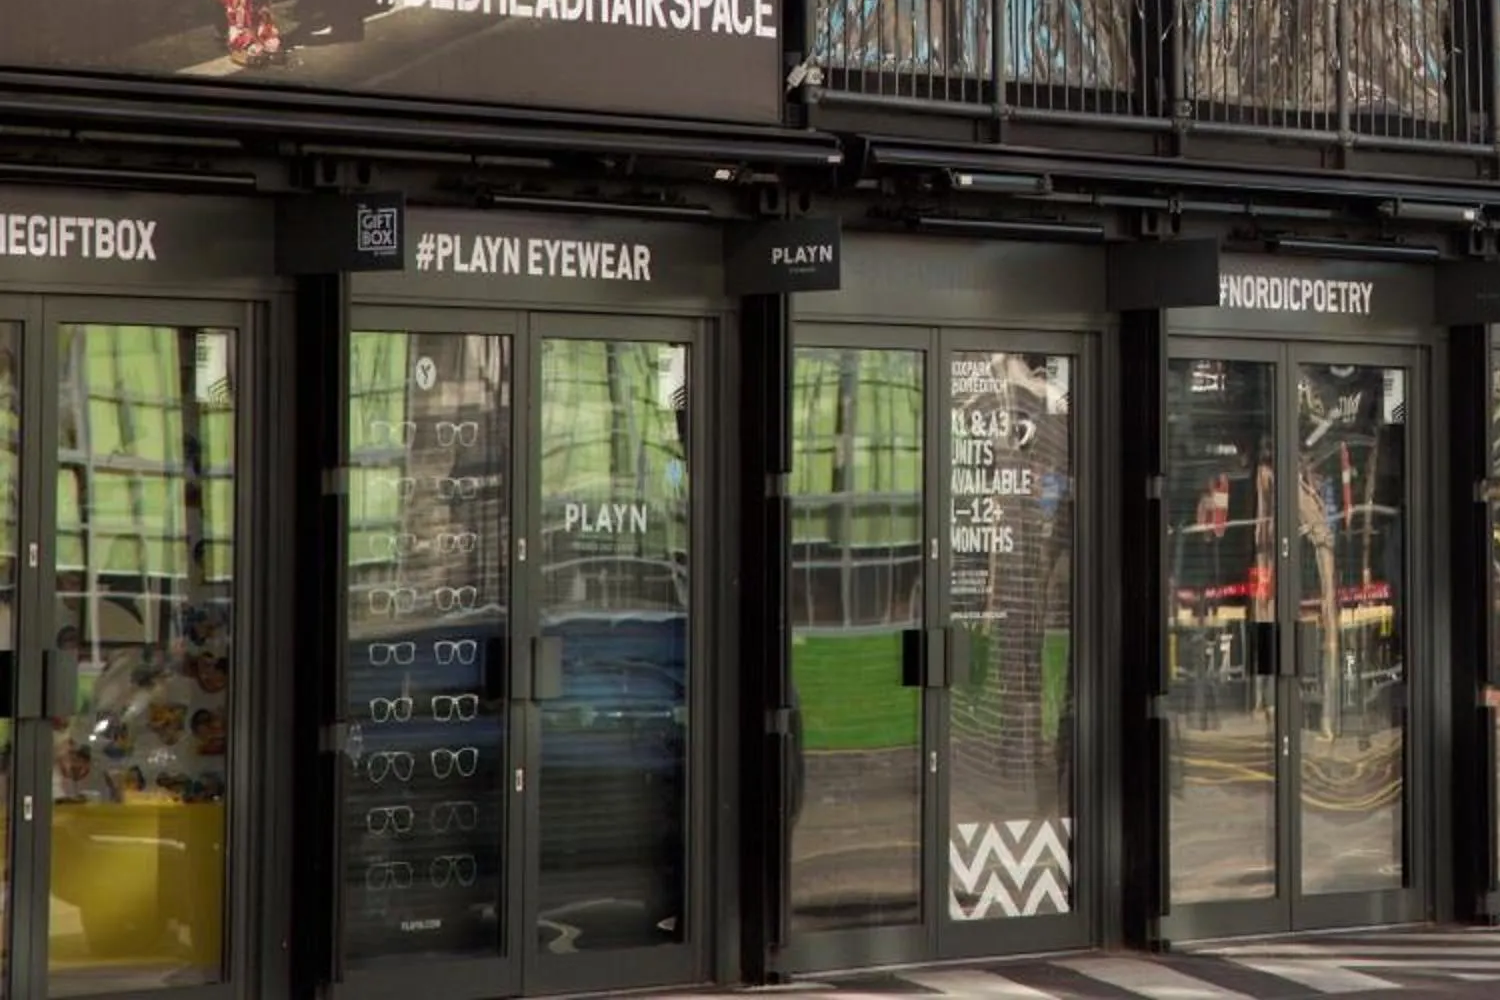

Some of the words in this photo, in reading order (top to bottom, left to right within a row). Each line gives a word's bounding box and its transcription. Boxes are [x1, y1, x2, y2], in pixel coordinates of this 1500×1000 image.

[416, 233, 520, 274] #PLAYN
[528, 239, 651, 281] EYEWEAR
[771, 245, 833, 264] PLAYN
[565, 503, 647, 534] PLAYN
